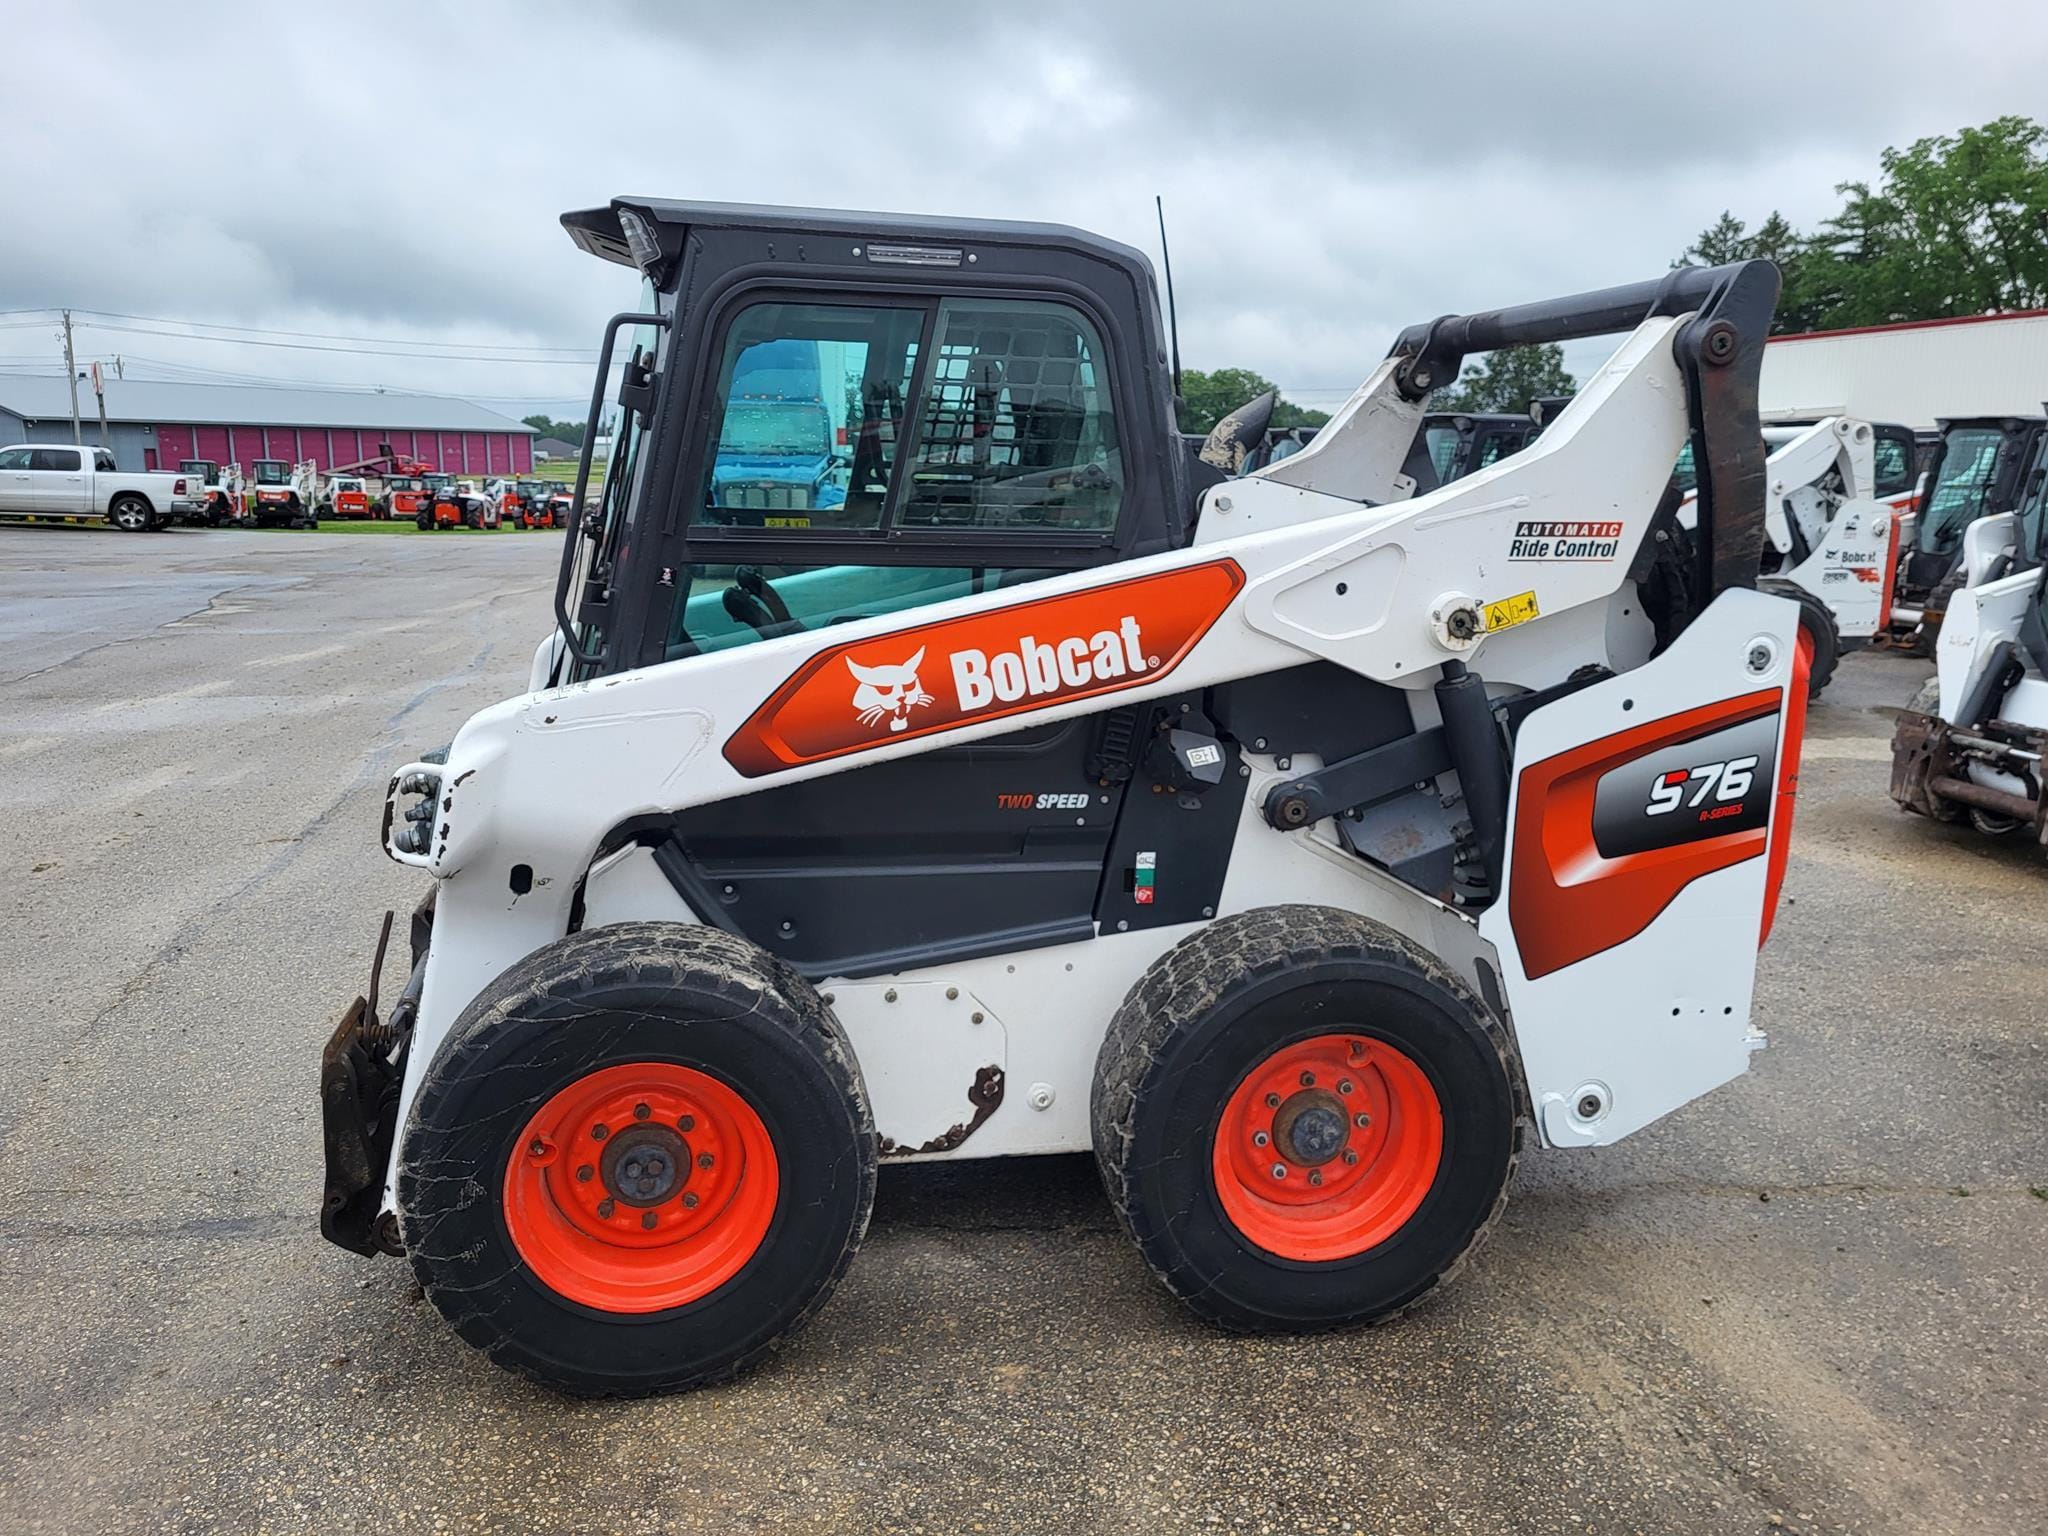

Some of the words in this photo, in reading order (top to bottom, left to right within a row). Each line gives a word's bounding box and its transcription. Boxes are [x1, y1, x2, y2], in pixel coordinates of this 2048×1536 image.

[1518, 524, 1621, 536] AUTOMATIC
[1509, 540, 1549, 557] Ride
[1554, 540, 1618, 557] Control
[950, 616, 1147, 712] Bobcat
[1646, 755, 1759, 815] S76
[997, 794, 1034, 809] TWO
[1036, 794, 1089, 809] SPEED
